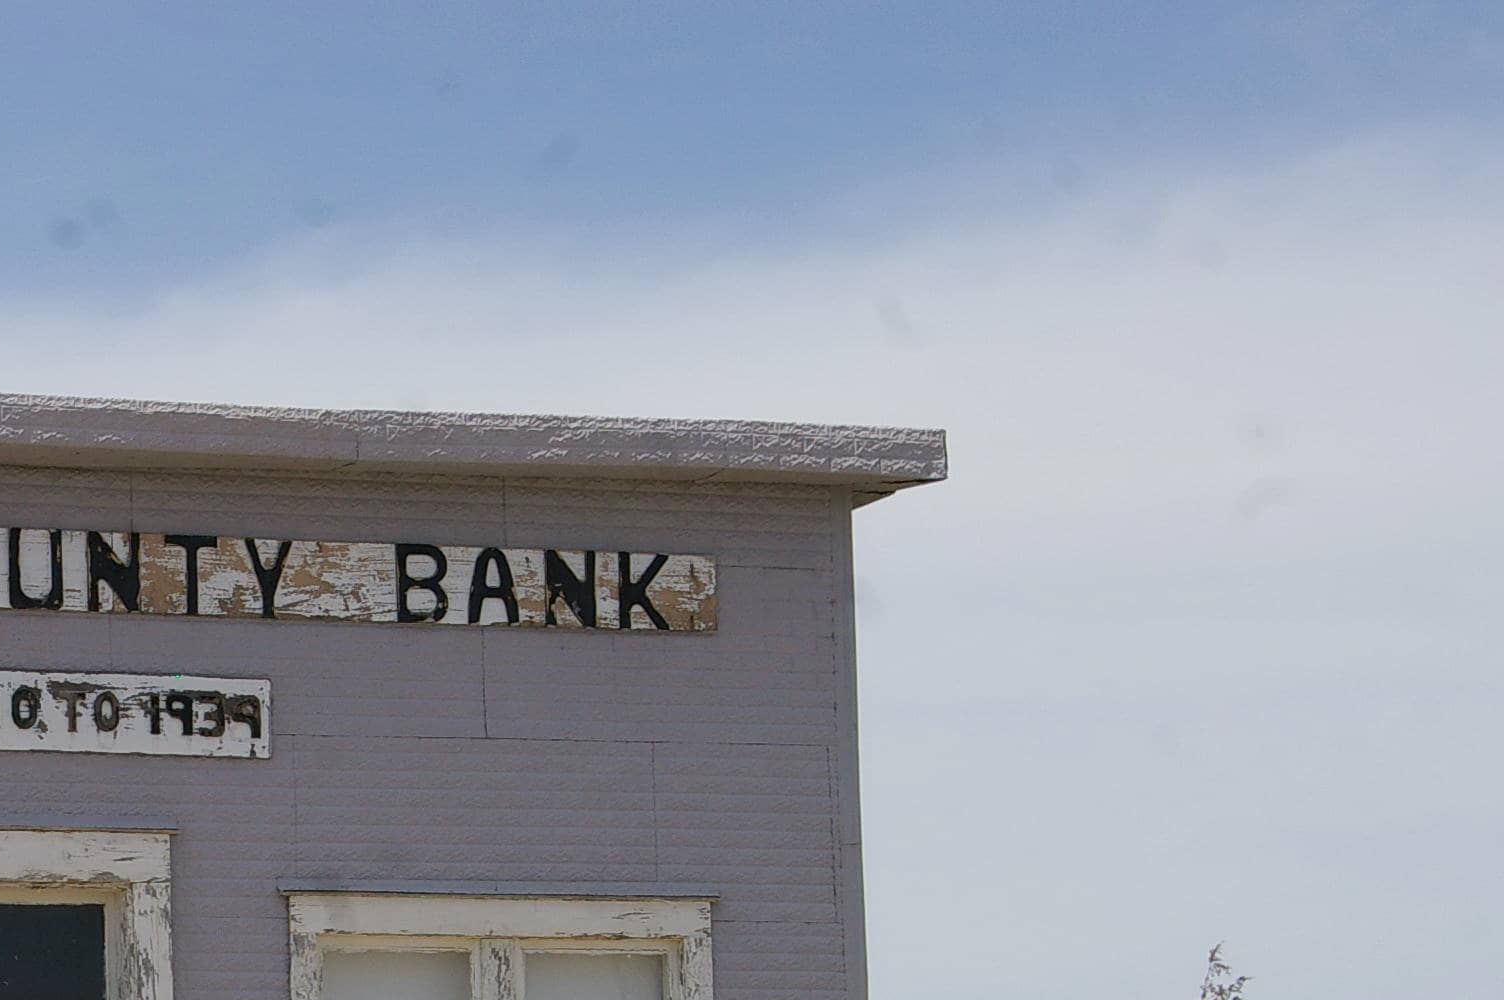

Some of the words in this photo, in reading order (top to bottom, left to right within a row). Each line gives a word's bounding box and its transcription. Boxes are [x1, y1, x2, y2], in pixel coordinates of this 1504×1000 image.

[396, 543, 670, 630] BANK
[52, 684, 120, 732] TO
[149, 691, 262, 739] 1939
